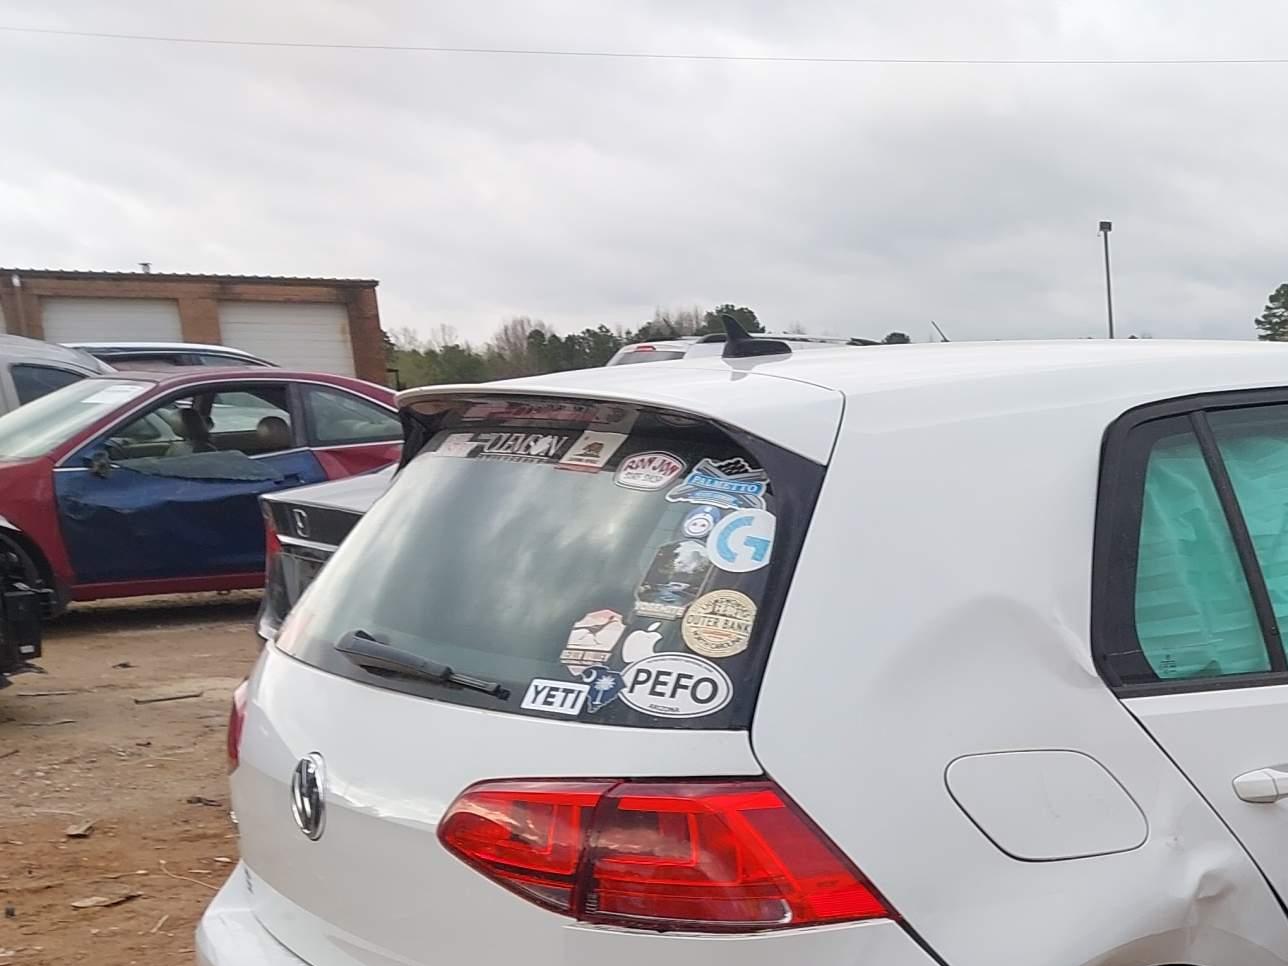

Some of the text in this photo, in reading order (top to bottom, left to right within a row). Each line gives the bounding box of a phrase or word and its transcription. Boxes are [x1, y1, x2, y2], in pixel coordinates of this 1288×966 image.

[691, 475, 758, 492] PALMETTO
[686, 614, 719, 628] OUTER
[628, 667, 719, 705] PEFO
[529, 684, 584, 711] YETI
